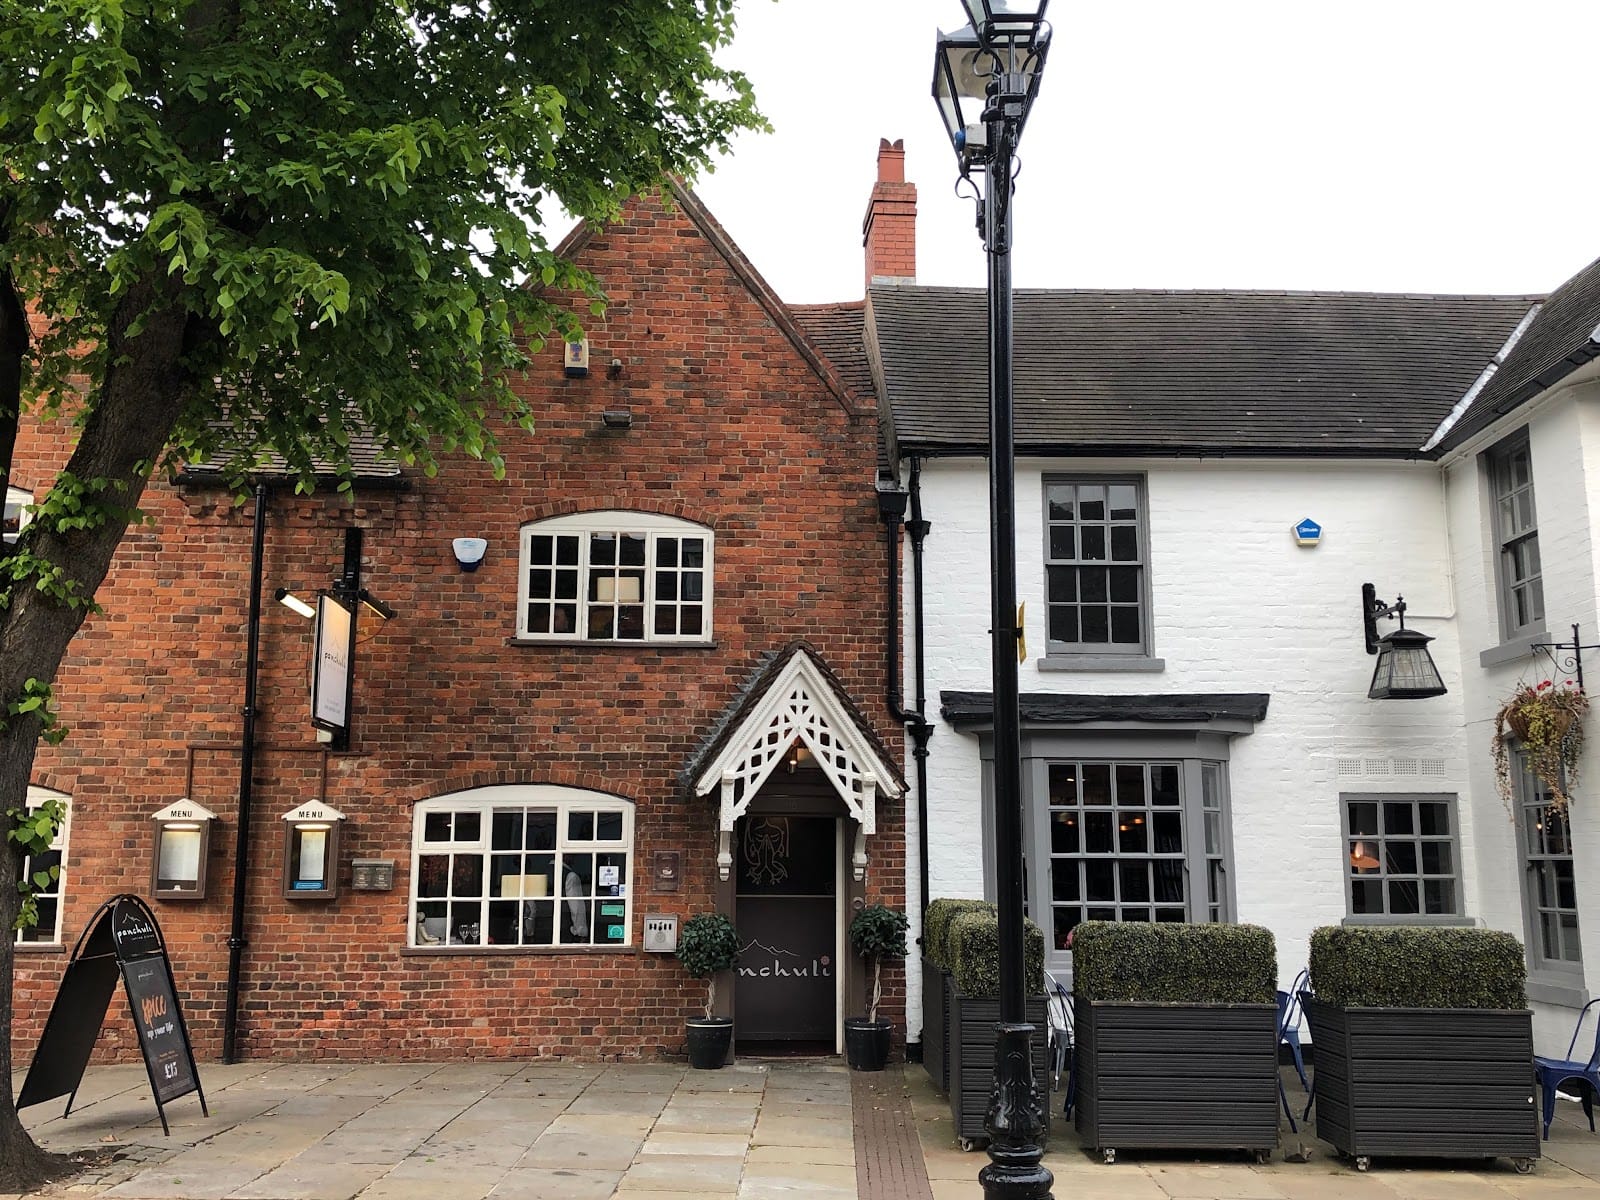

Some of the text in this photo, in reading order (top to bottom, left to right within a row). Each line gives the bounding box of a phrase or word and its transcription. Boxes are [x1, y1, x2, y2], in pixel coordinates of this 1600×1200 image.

[170, 810, 193, 818] MENU
[298, 810, 323, 818] MENU
[117, 923, 153, 945] panchuli
[738, 955, 831, 977] nchuli
[154, 1026, 166, 1039] your
[165, 1021, 174, 1035] life
[164, 1061, 178, 1079] £15
